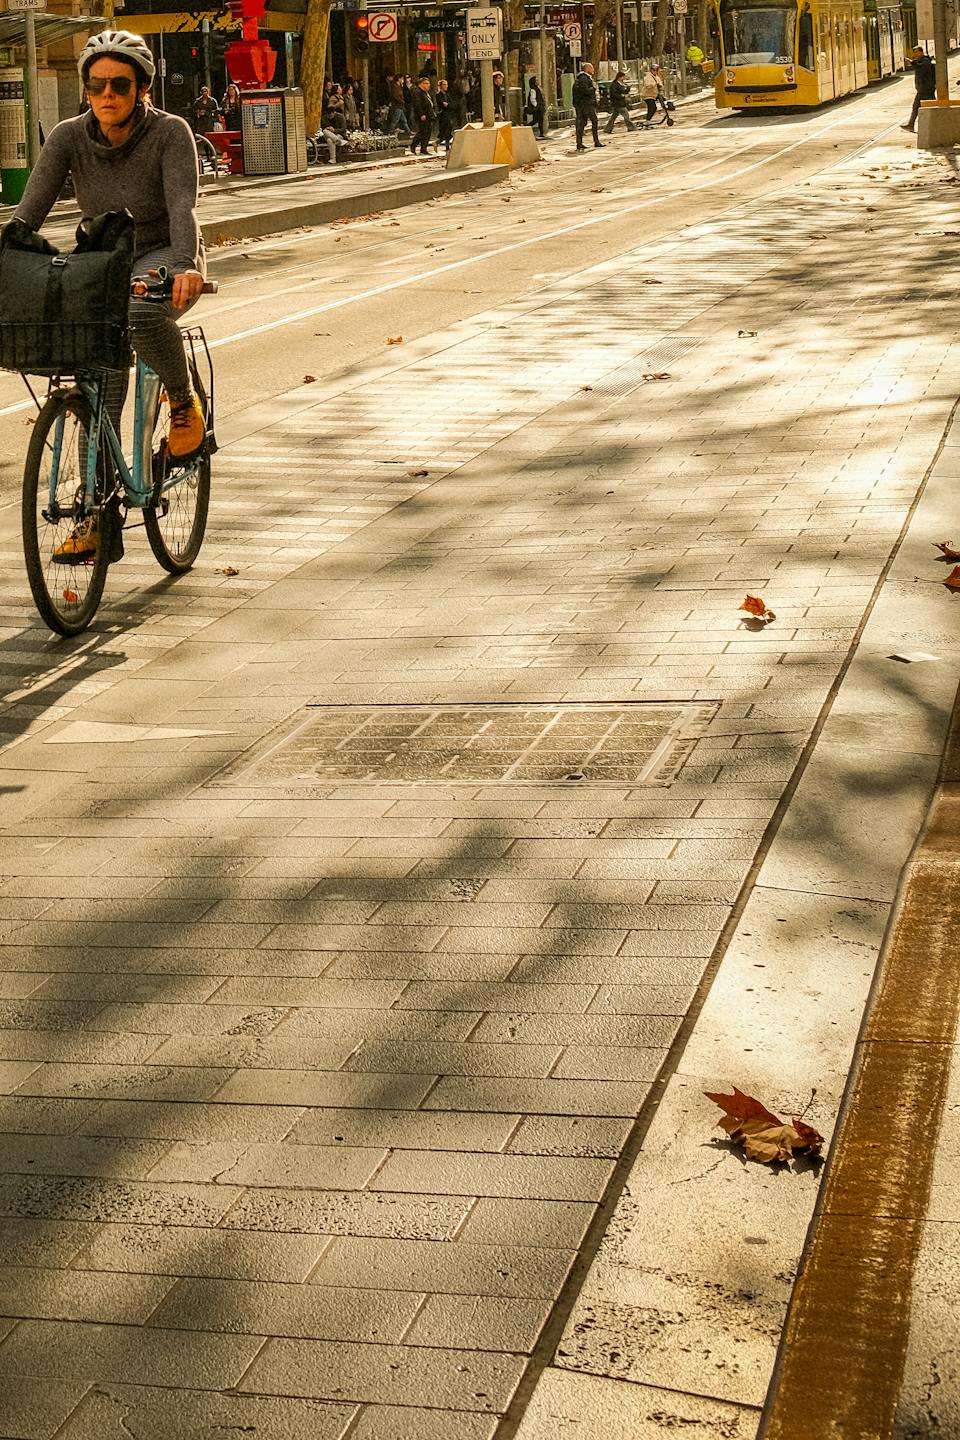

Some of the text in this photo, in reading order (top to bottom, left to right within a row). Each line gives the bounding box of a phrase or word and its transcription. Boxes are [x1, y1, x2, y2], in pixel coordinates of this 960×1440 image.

[16, 0, 38, 8] TRAMS
[471, 33, 496, 44] ONLY
[775, 56, 793, 64] 3530
